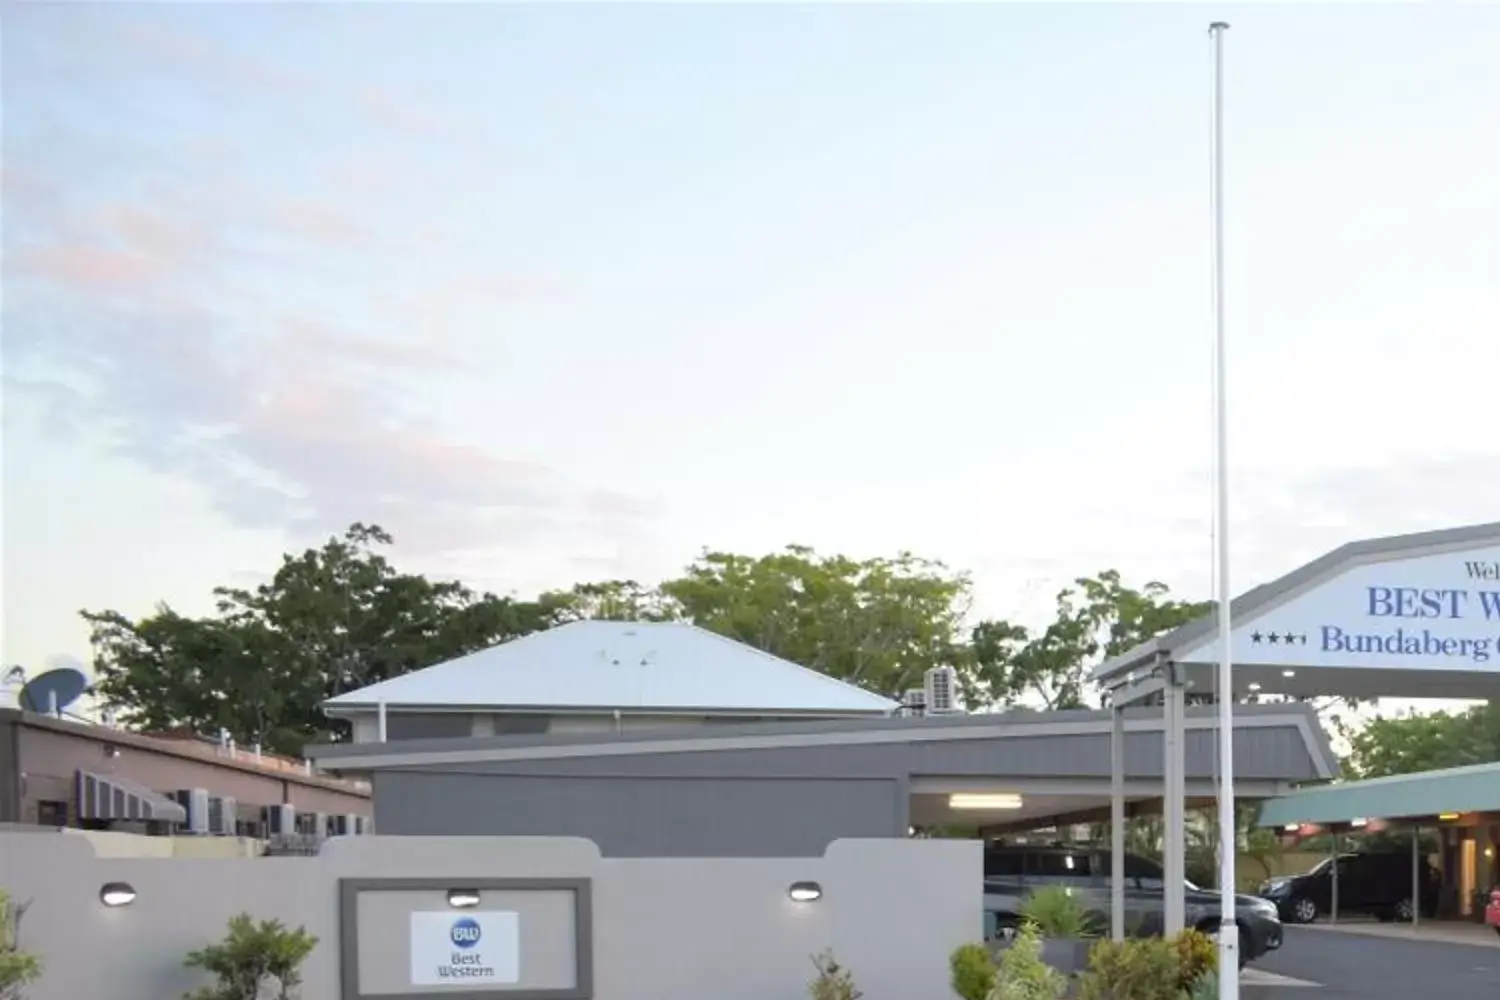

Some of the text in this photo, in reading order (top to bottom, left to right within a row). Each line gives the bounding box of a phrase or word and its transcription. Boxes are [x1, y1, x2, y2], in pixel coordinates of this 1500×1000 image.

[1367, 586, 1467, 619] BEST
[1321, 625, 1492, 663] Bundaberg
[453, 927, 479, 941] BW
[451, 953, 480, 965] Best
[438, 965, 494, 977] Western
